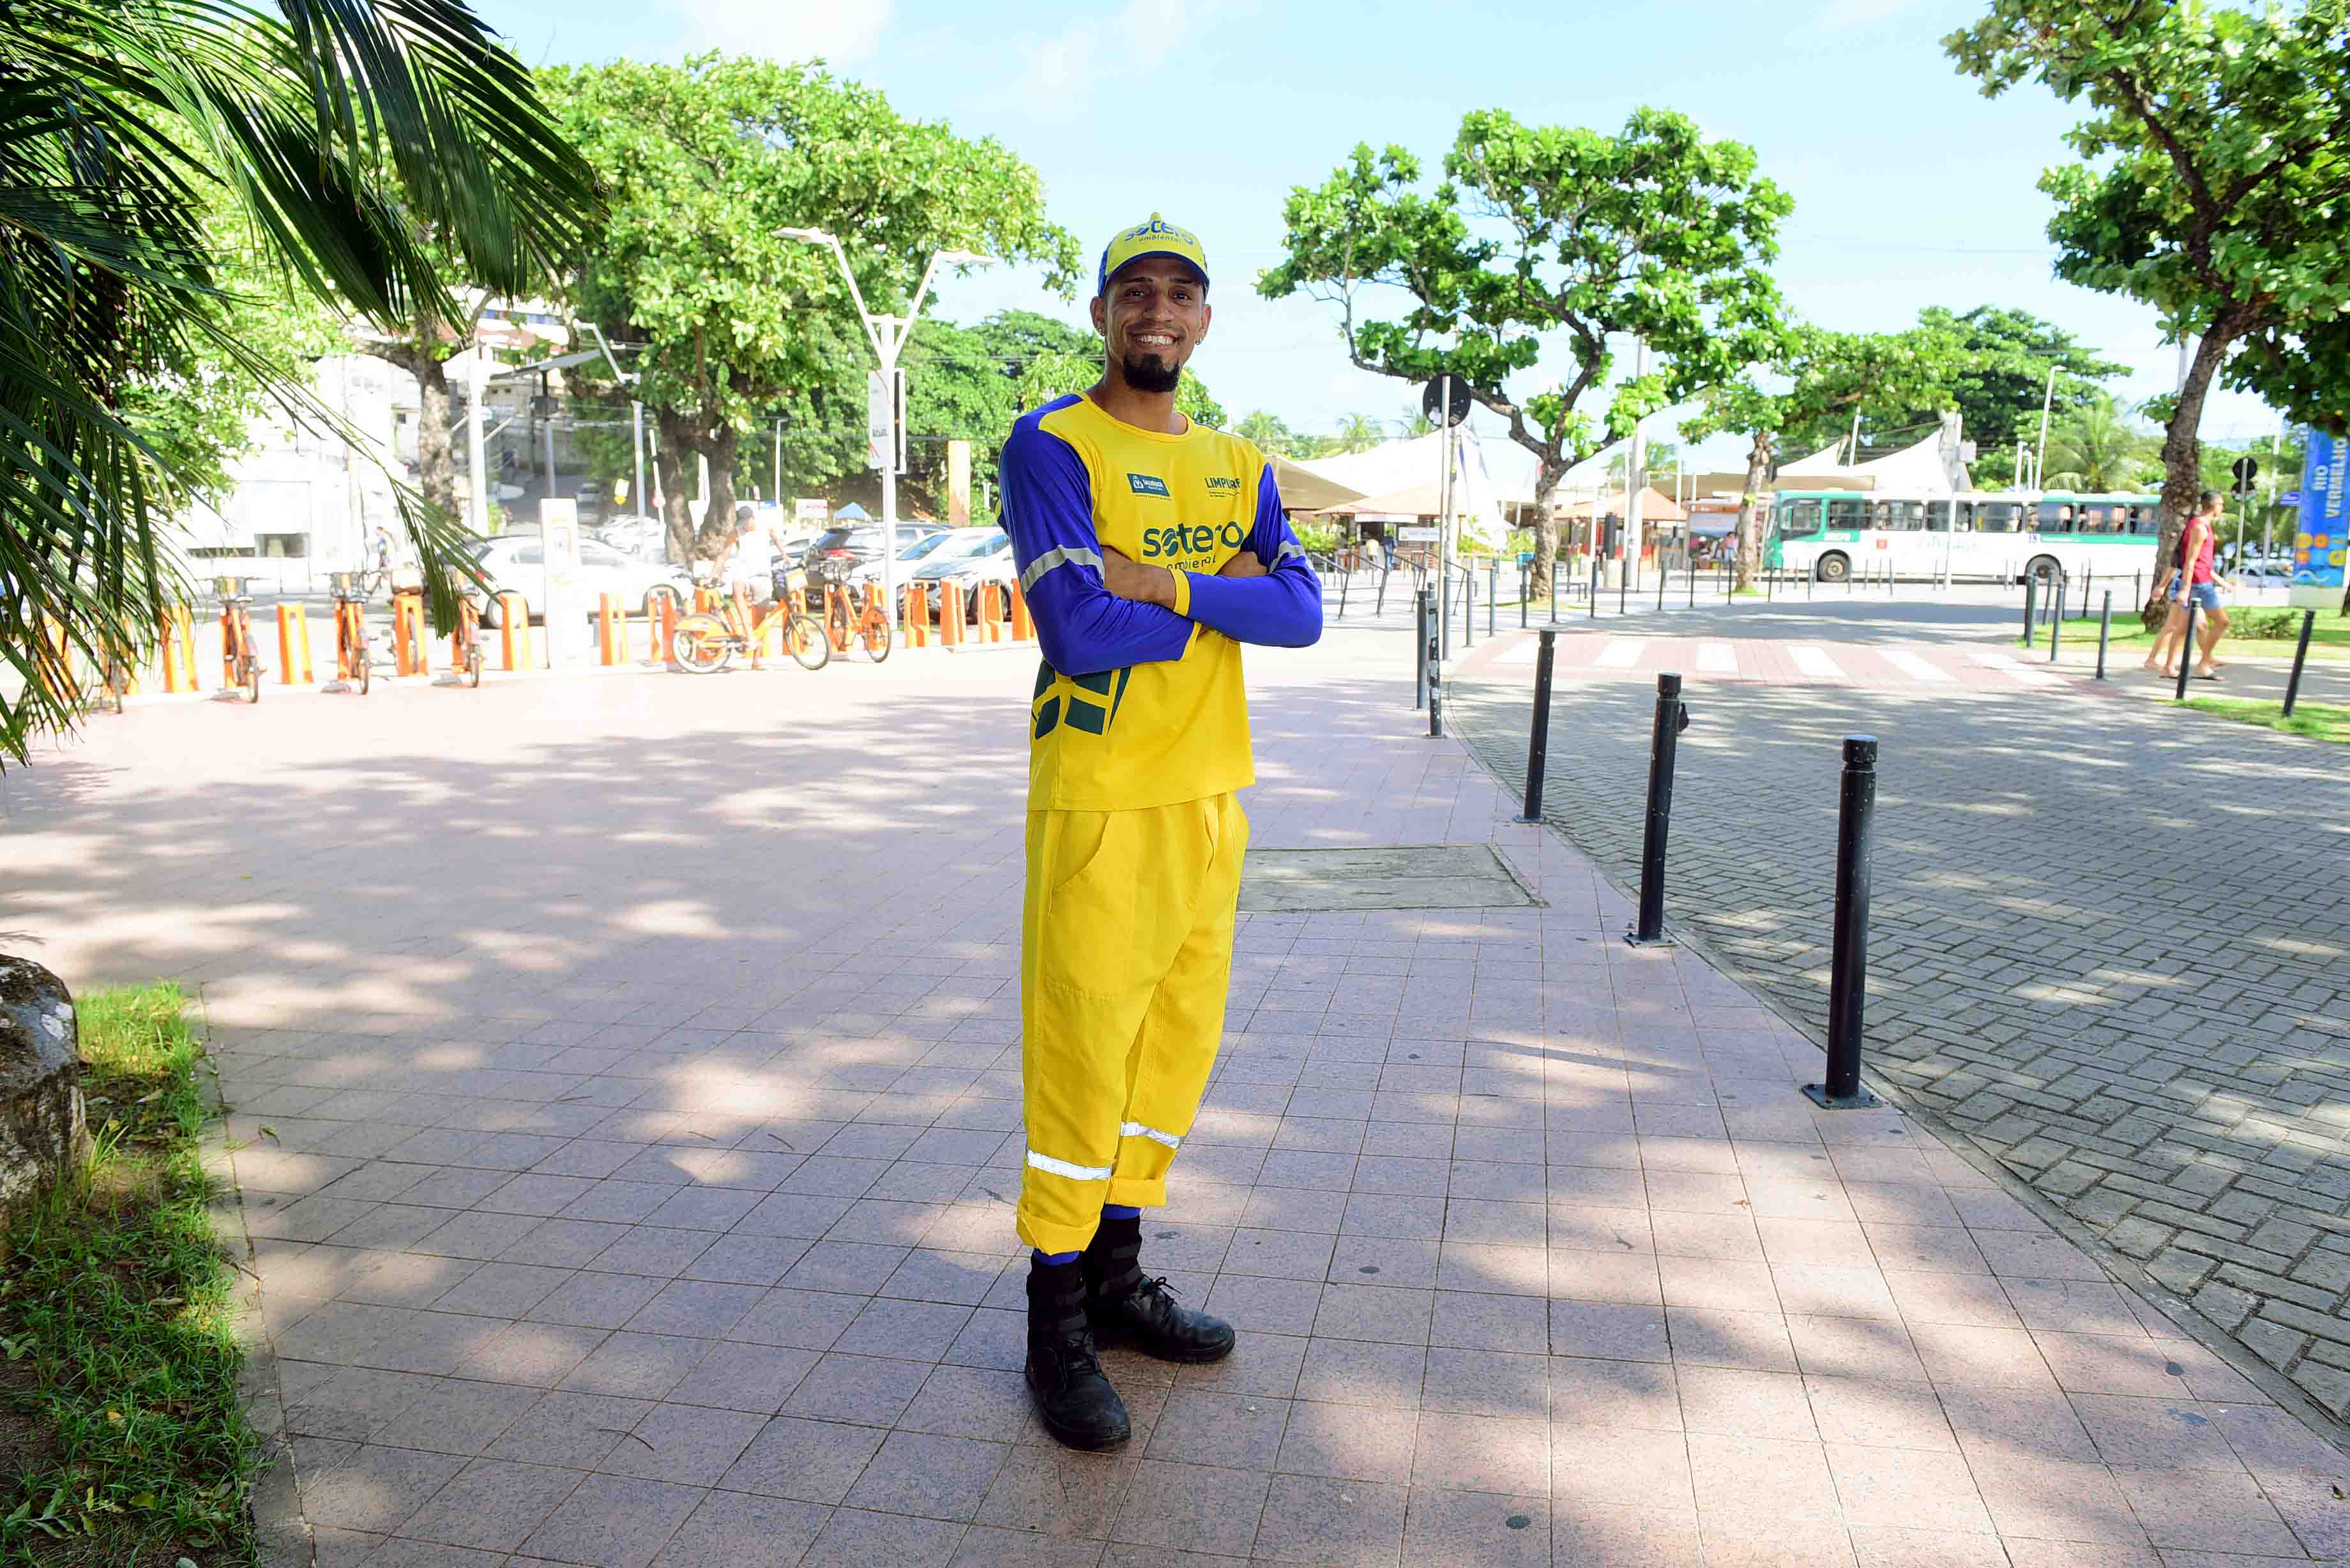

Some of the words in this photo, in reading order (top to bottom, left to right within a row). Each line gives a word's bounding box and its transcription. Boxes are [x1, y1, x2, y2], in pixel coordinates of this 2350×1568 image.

[2313, 465, 2329, 490] RIO
[2325, 437, 2347, 518] VERMELHO
[1166, 555, 1216, 571] ambienal
